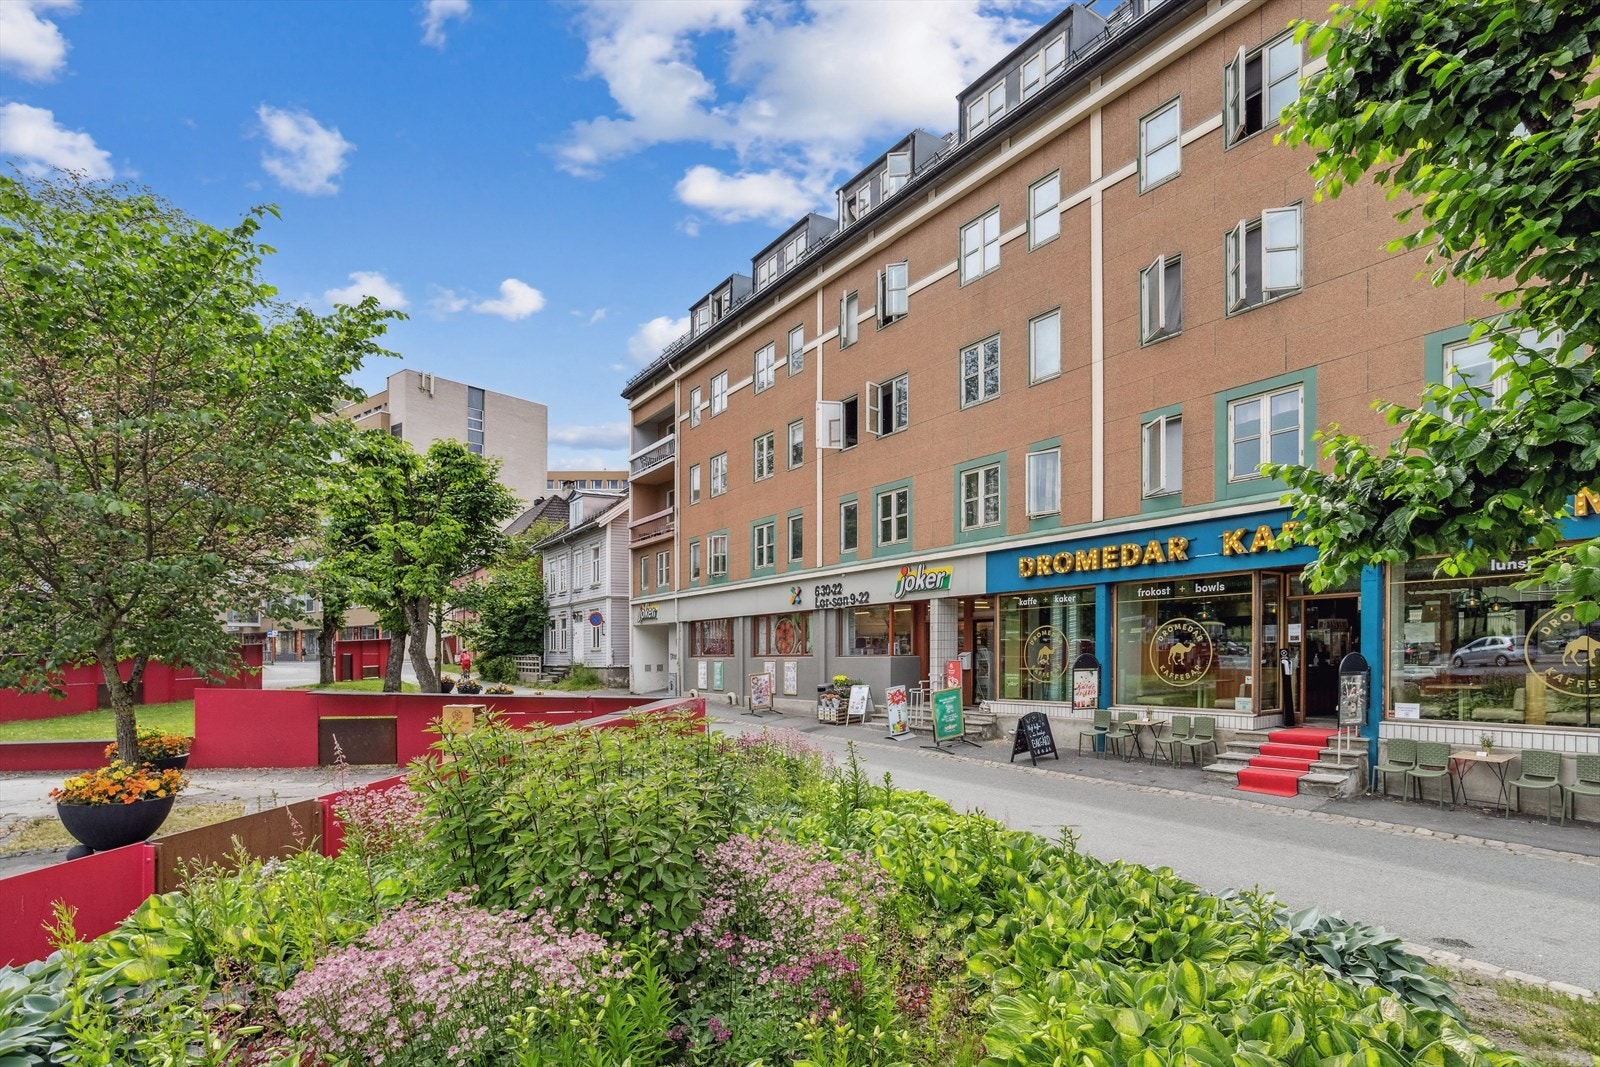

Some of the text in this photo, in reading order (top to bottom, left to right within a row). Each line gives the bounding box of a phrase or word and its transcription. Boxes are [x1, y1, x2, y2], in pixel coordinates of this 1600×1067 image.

[1018, 520, 1319, 578] DROMEDAR KAF
[895, 563, 947, 599] joker
[1137, 586, 1171, 597] frokost
[1195, 581, 1225, 593] bowls
[1019, 596, 1038, 606] kaffe
[1054, 594, 1077, 604] kaker
[1157, 623, 1204, 642] DROMEDAR
[1540, 612, 1574, 636] DRO
[1159, 664, 1202, 681] KAFFEBAR
[1545, 666, 1600, 690] KAFFE
